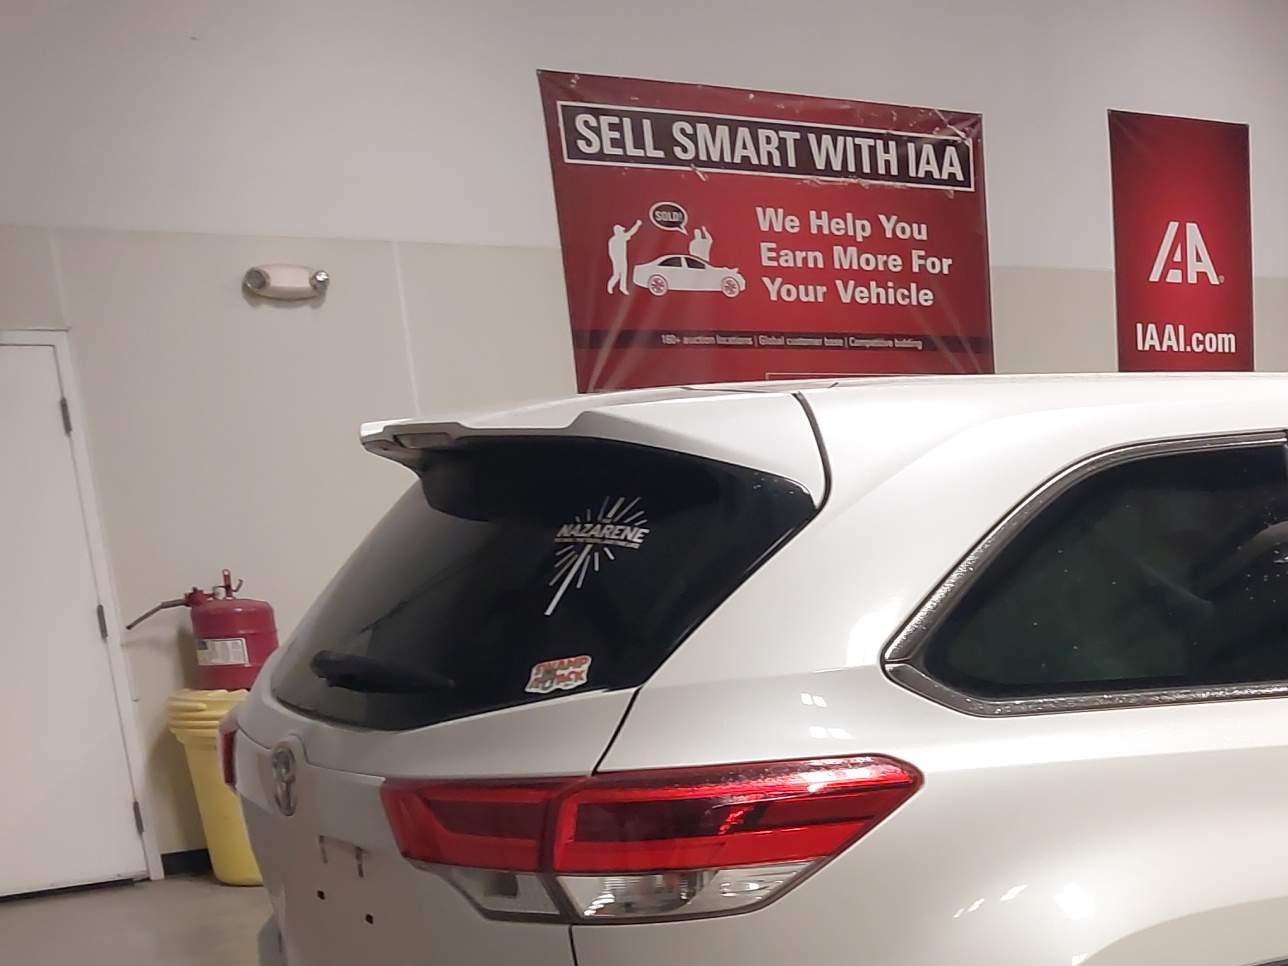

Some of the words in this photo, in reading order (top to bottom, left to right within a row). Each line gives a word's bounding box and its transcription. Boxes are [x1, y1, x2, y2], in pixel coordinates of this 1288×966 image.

[575, 114, 665, 158] SELL
[672, 120, 801, 168] SMART
[807, 132, 899, 176] WITH
[907, 142, 965, 181] IAA
[756, 206, 800, 233] We
[809, 210, 872, 242] Help
[878, 214, 928, 241] You
[759, 242, 825, 268] Earn
[833, 245, 903, 272] More
[911, 249, 953, 275] For
[761, 276, 827, 303] Your
[835, 279, 934, 306] Vehicle
[1136, 323, 1236, 353] IAAI.com
[556, 523, 650, 543] NAZARENE
